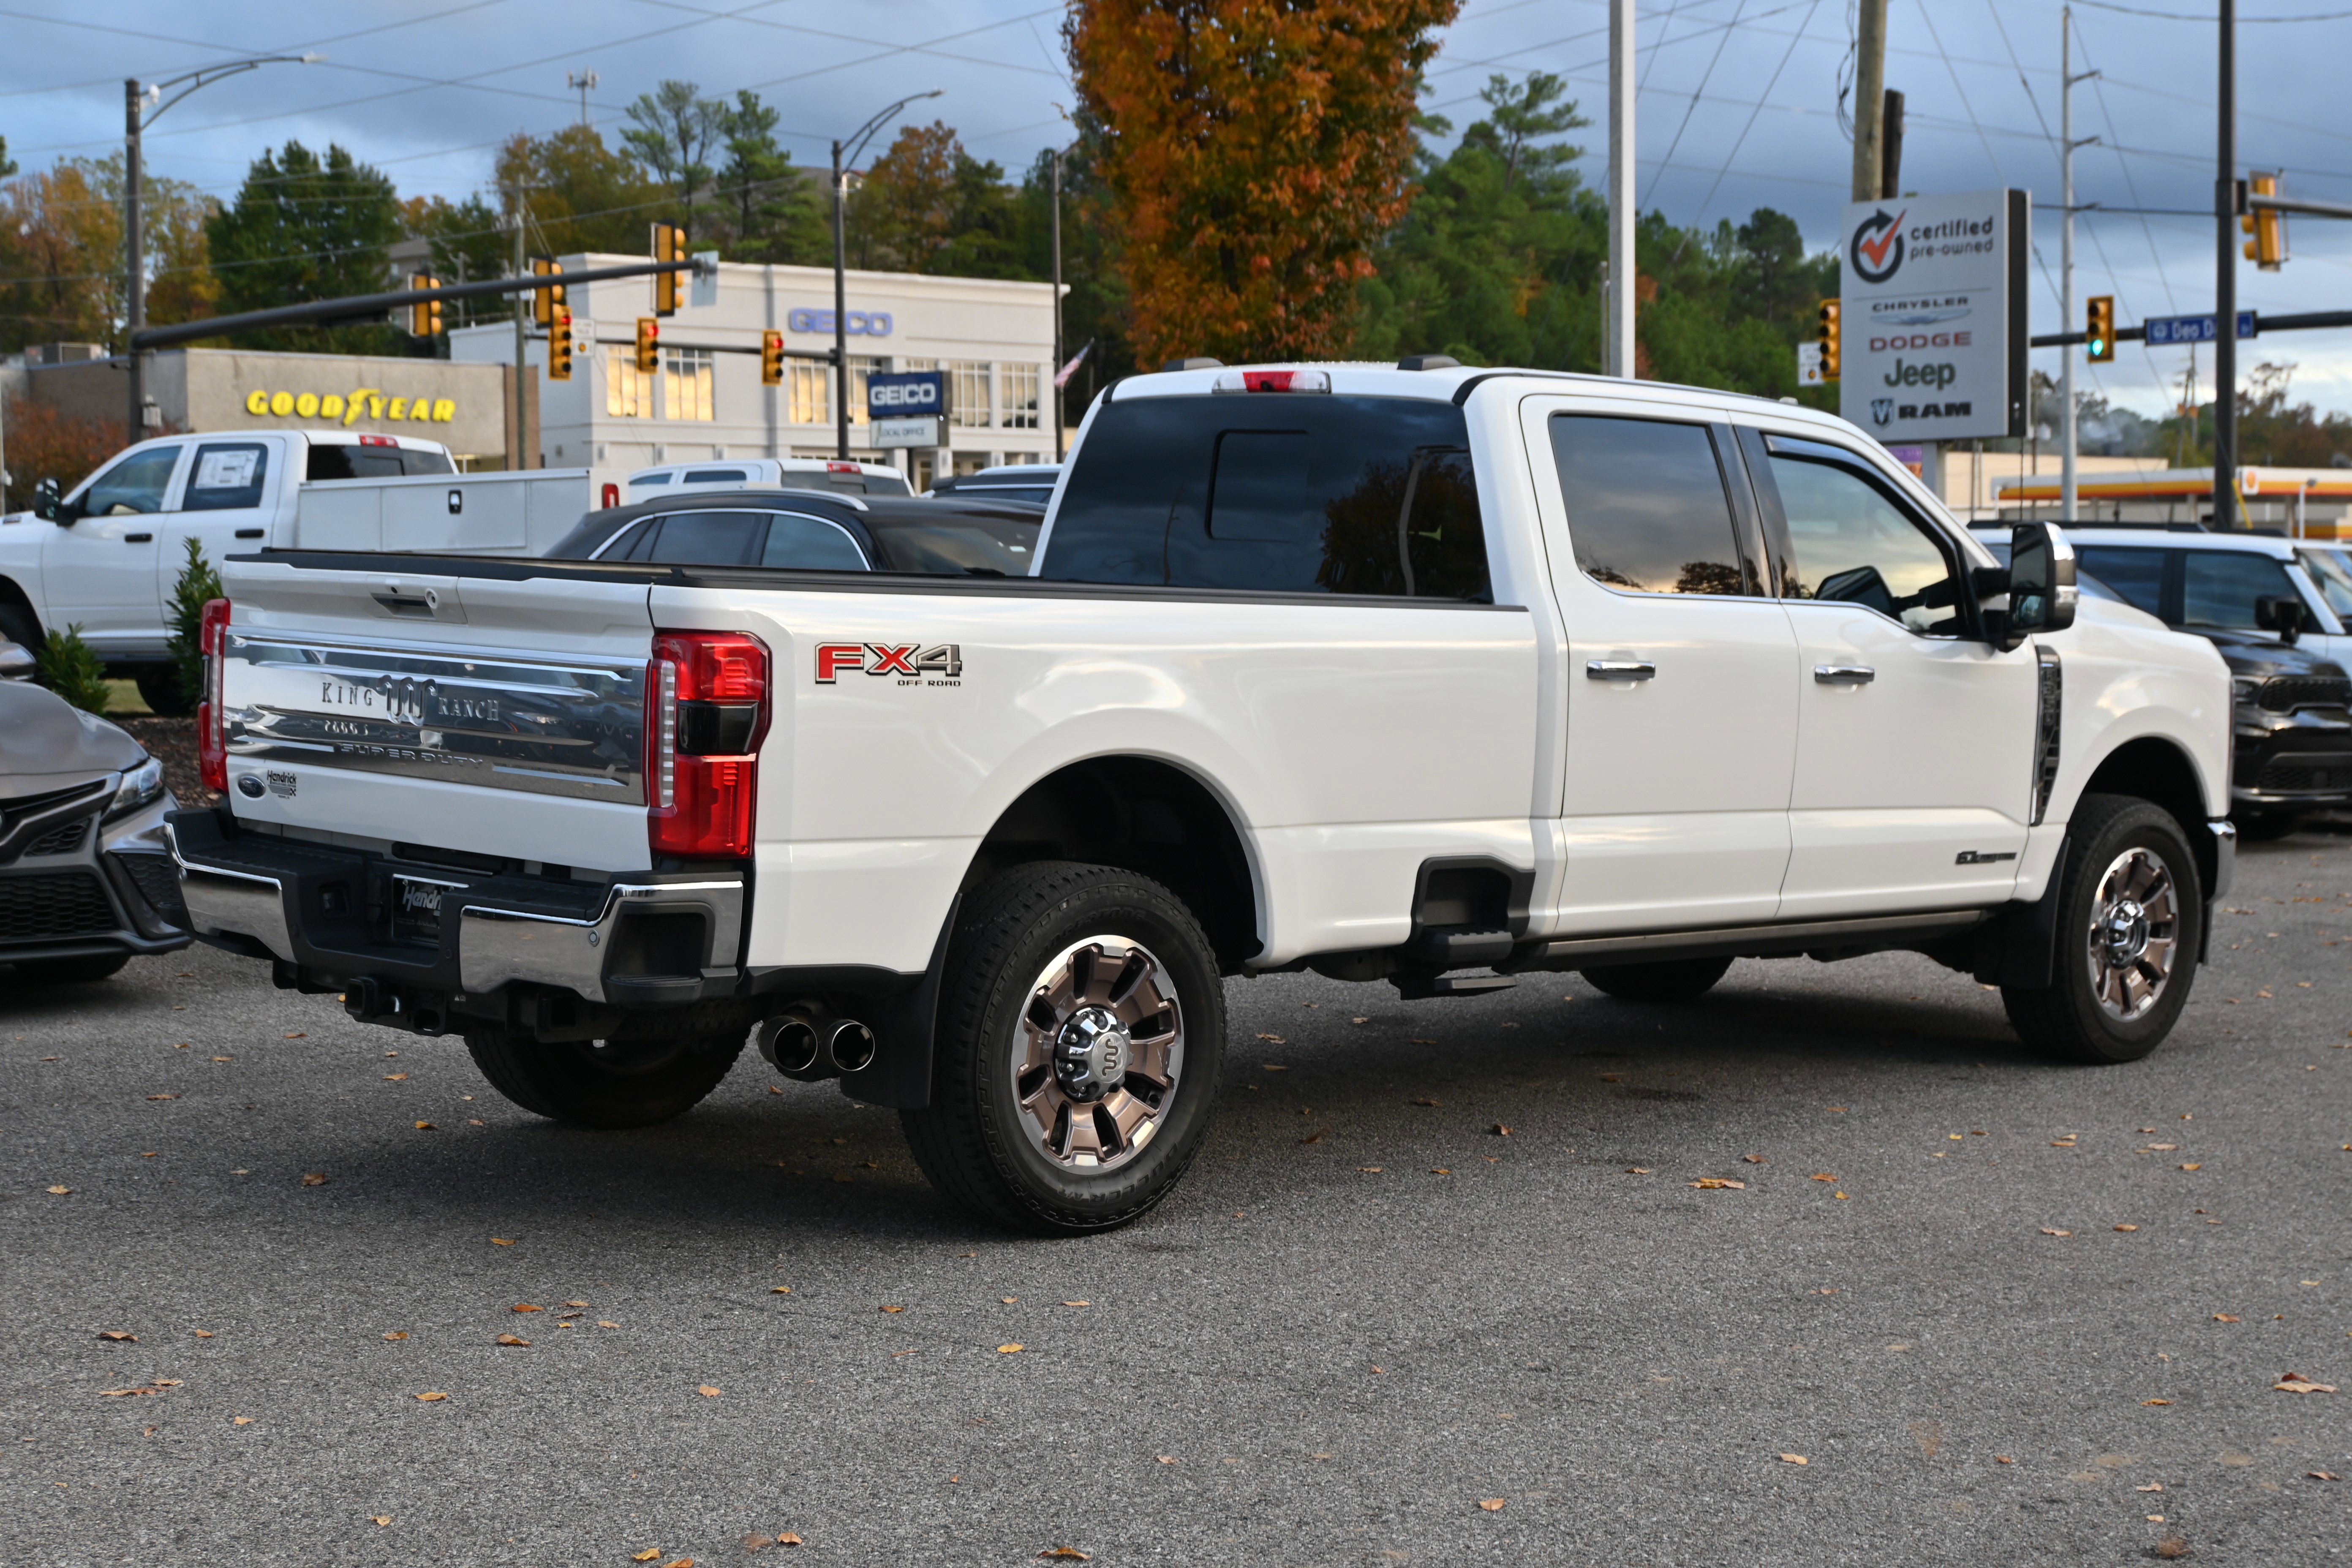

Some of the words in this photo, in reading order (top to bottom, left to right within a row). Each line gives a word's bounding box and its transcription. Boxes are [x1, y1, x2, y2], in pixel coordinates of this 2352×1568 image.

[1911, 216, 1993, 240] certified
[1910, 237, 1993, 261] pre-owned
[1873, 297, 1968, 312] CHRYSLER
[789, 308, 893, 336] GECO
[1870, 332, 1971, 352] DODGE
[1884, 358, 1956, 391] Jeep
[247, 389, 456, 424] GOODYEAR
[871, 383, 936, 406] GEICO
[1899, 402, 1971, 419] RAM
[902, 426, 925, 436] OFFICE
[815, 642, 962, 685] FX4
[322, 682, 372, 706] KING
[438, 697, 499, 721] RANCH
[340, 743, 416, 760] SUPER
[422, 752, 483, 769] DUTY
[267, 770, 297, 784] Hendrick
